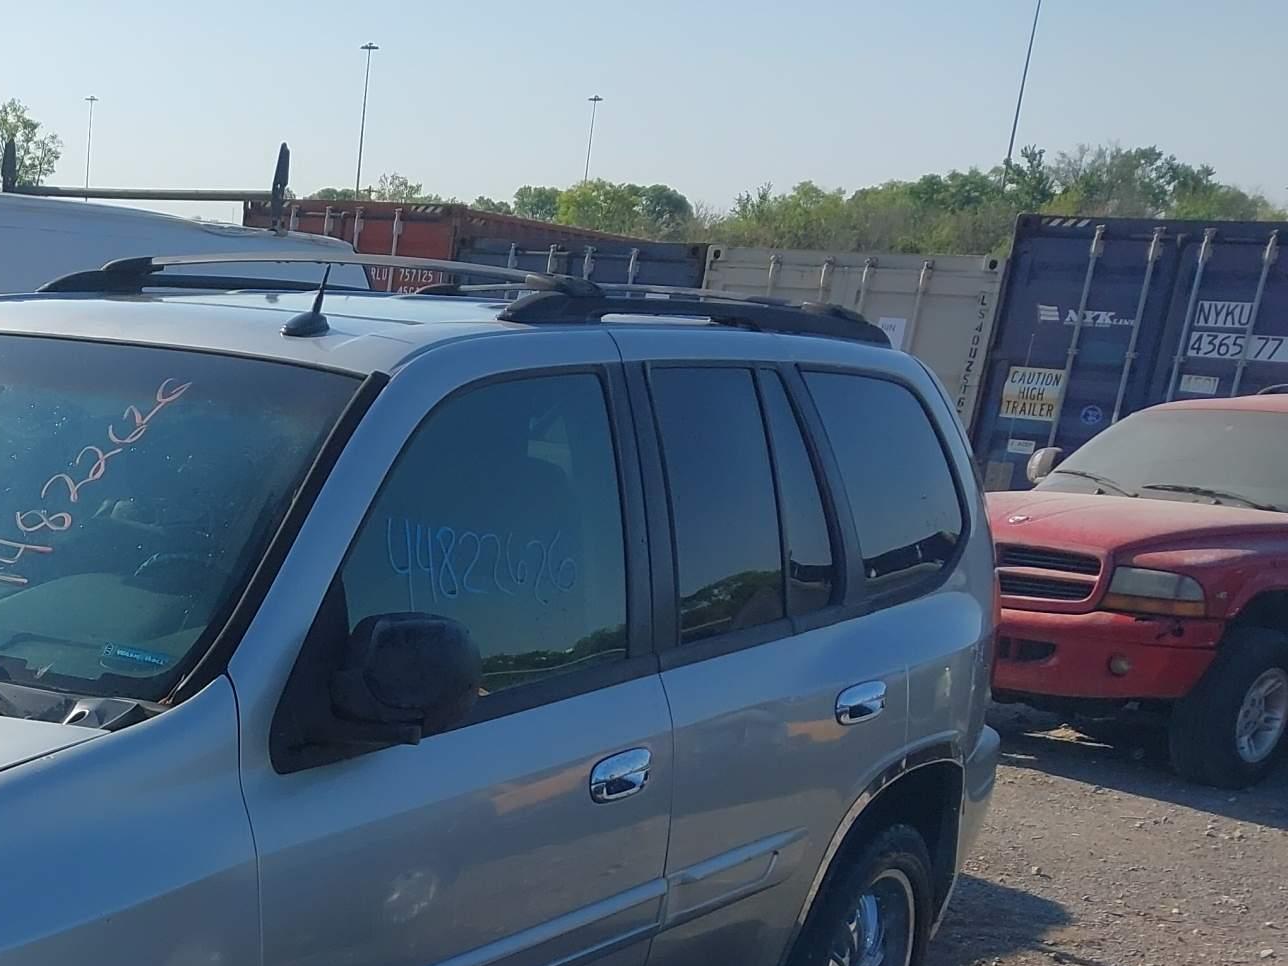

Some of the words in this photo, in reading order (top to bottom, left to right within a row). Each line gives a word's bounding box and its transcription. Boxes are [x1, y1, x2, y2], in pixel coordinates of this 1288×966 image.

[399, 268, 433, 283] 757125
[1064, 308, 1116, 327] NYK
[1196, 303, 1253, 326] NYKU
[1010, 370, 1063, 387] CAUTION
[1018, 387, 1046, 401] HIGH
[1005, 400, 1055, 417] TRAILER
[385, 516, 578, 613] 44822626
